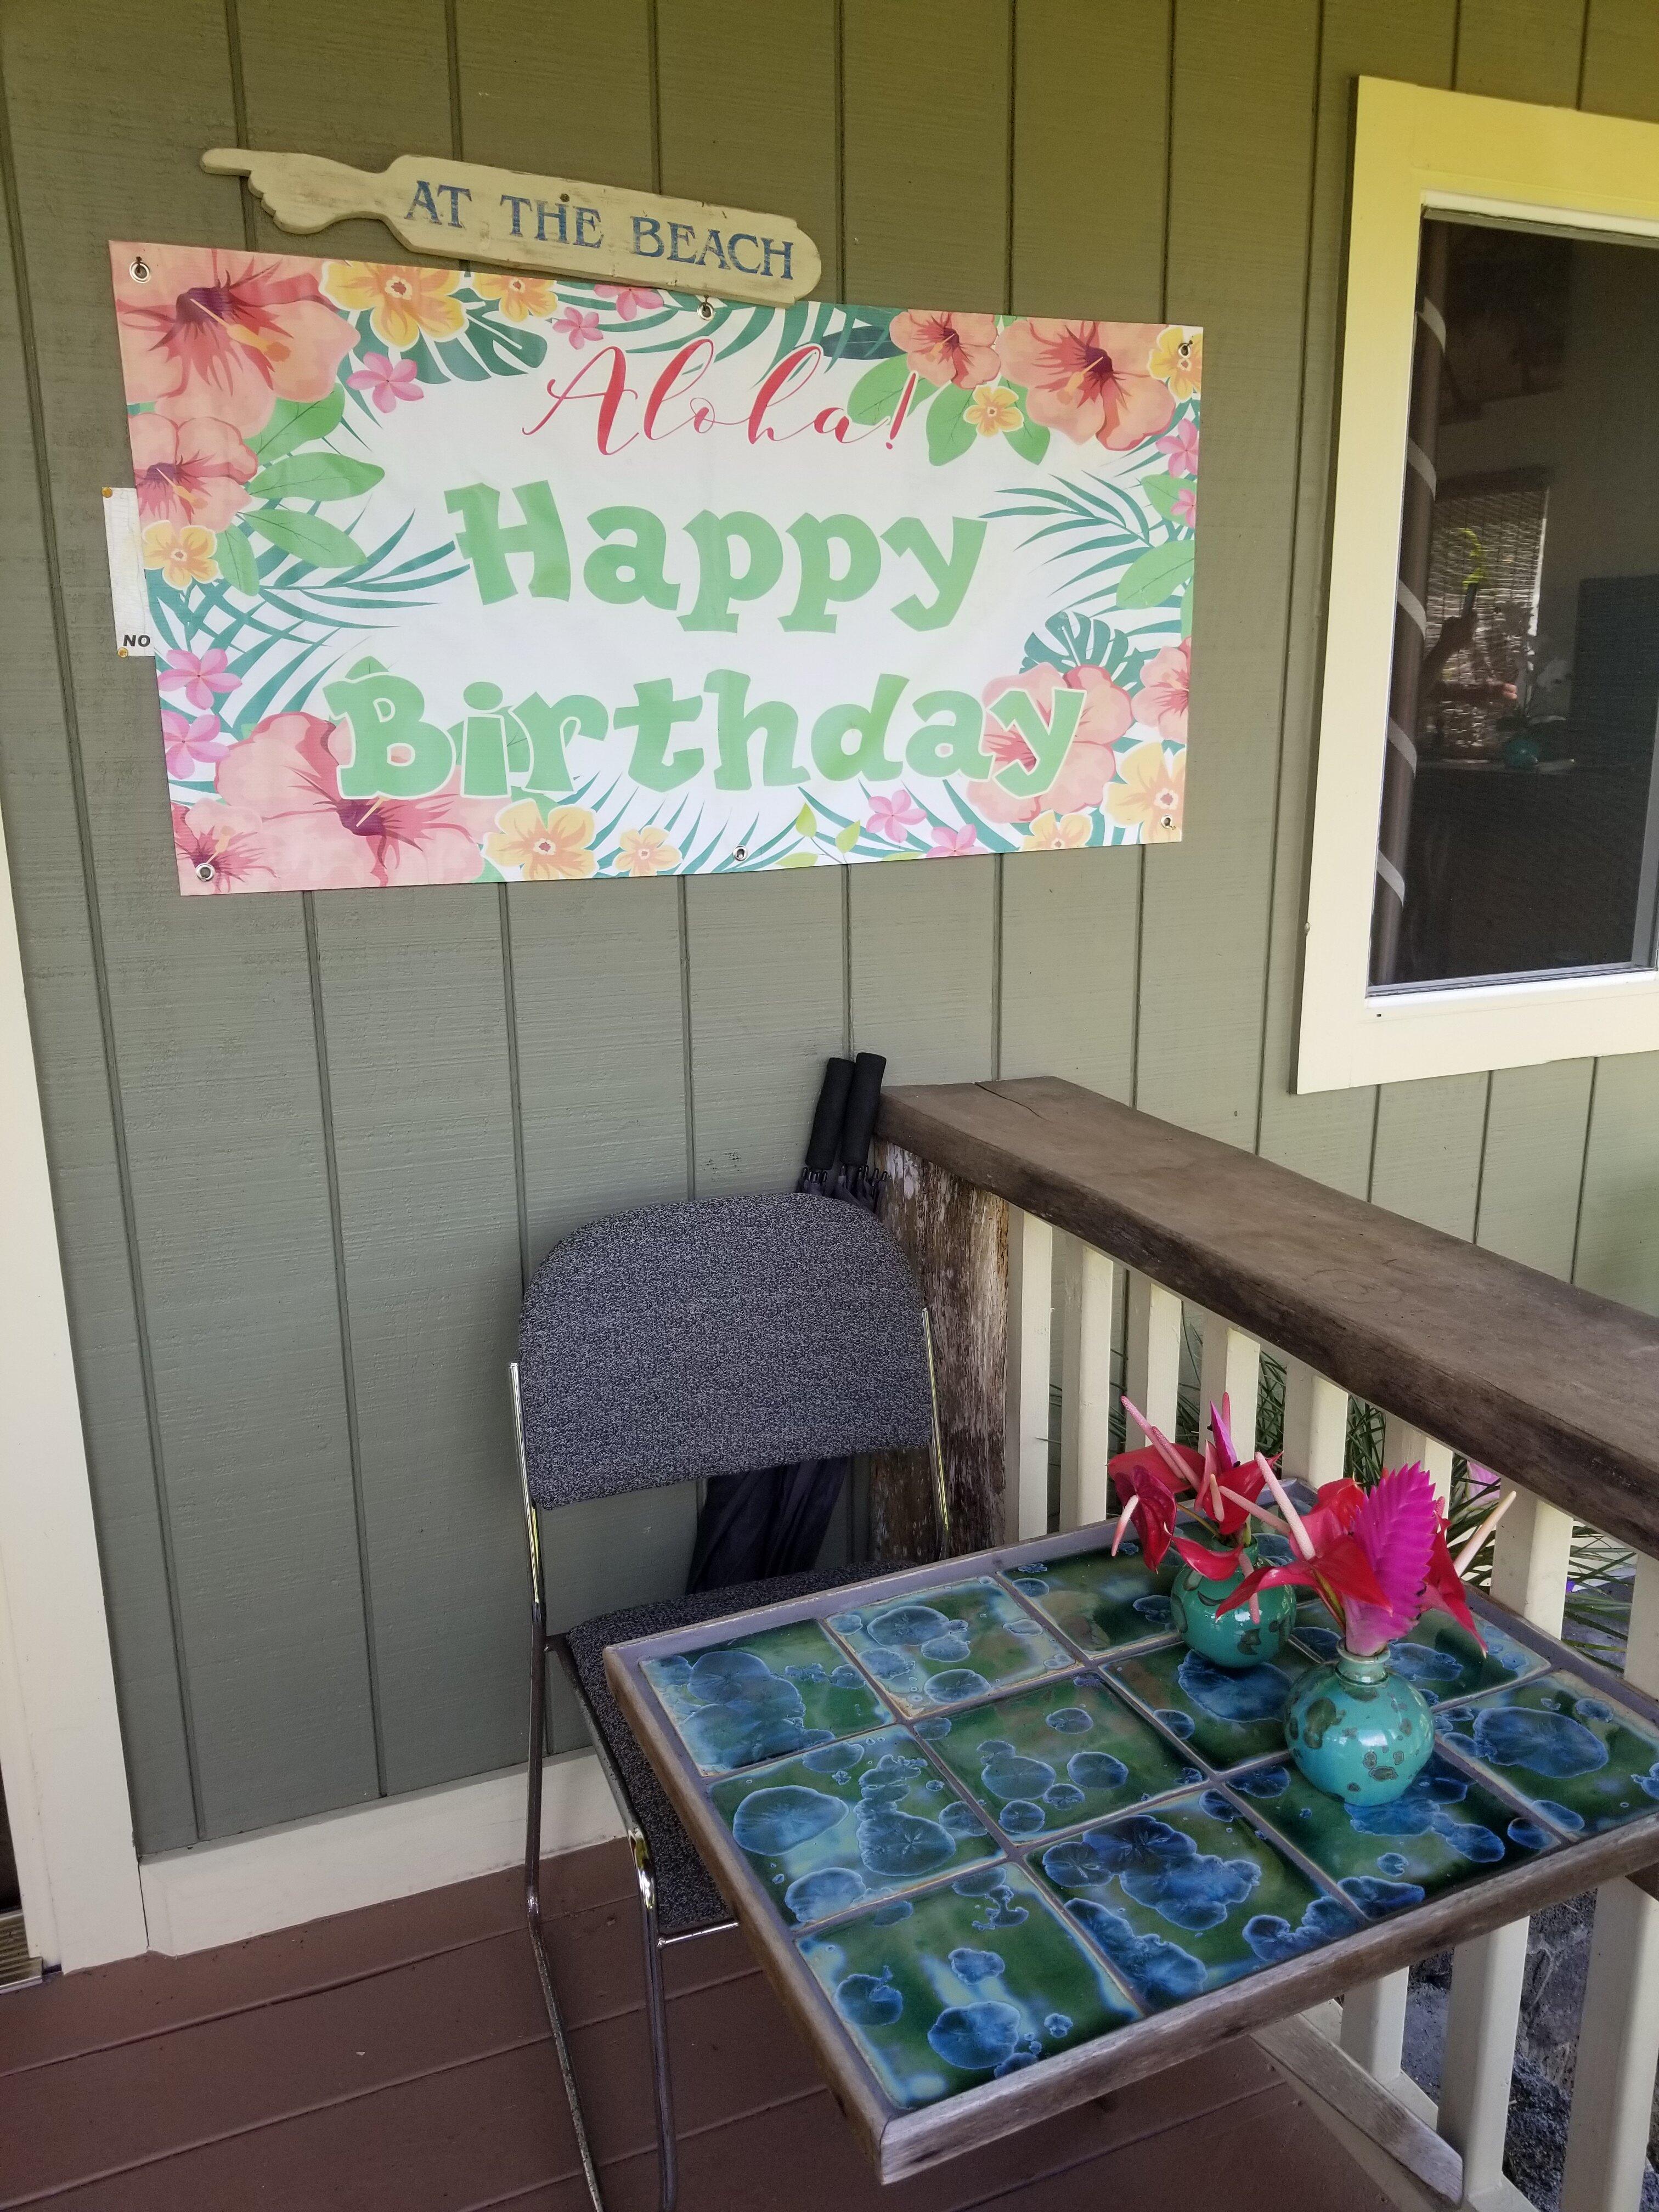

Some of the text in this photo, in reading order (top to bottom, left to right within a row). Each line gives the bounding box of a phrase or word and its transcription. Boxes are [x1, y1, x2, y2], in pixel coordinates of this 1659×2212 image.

[404, 180, 795, 281] AT THE BEACH
[521, 338, 917, 456] Aloha!
[443, 479, 988, 634] Happy
[122, 634, 151, 647] NO
[327, 669, 1087, 798] Birthday
